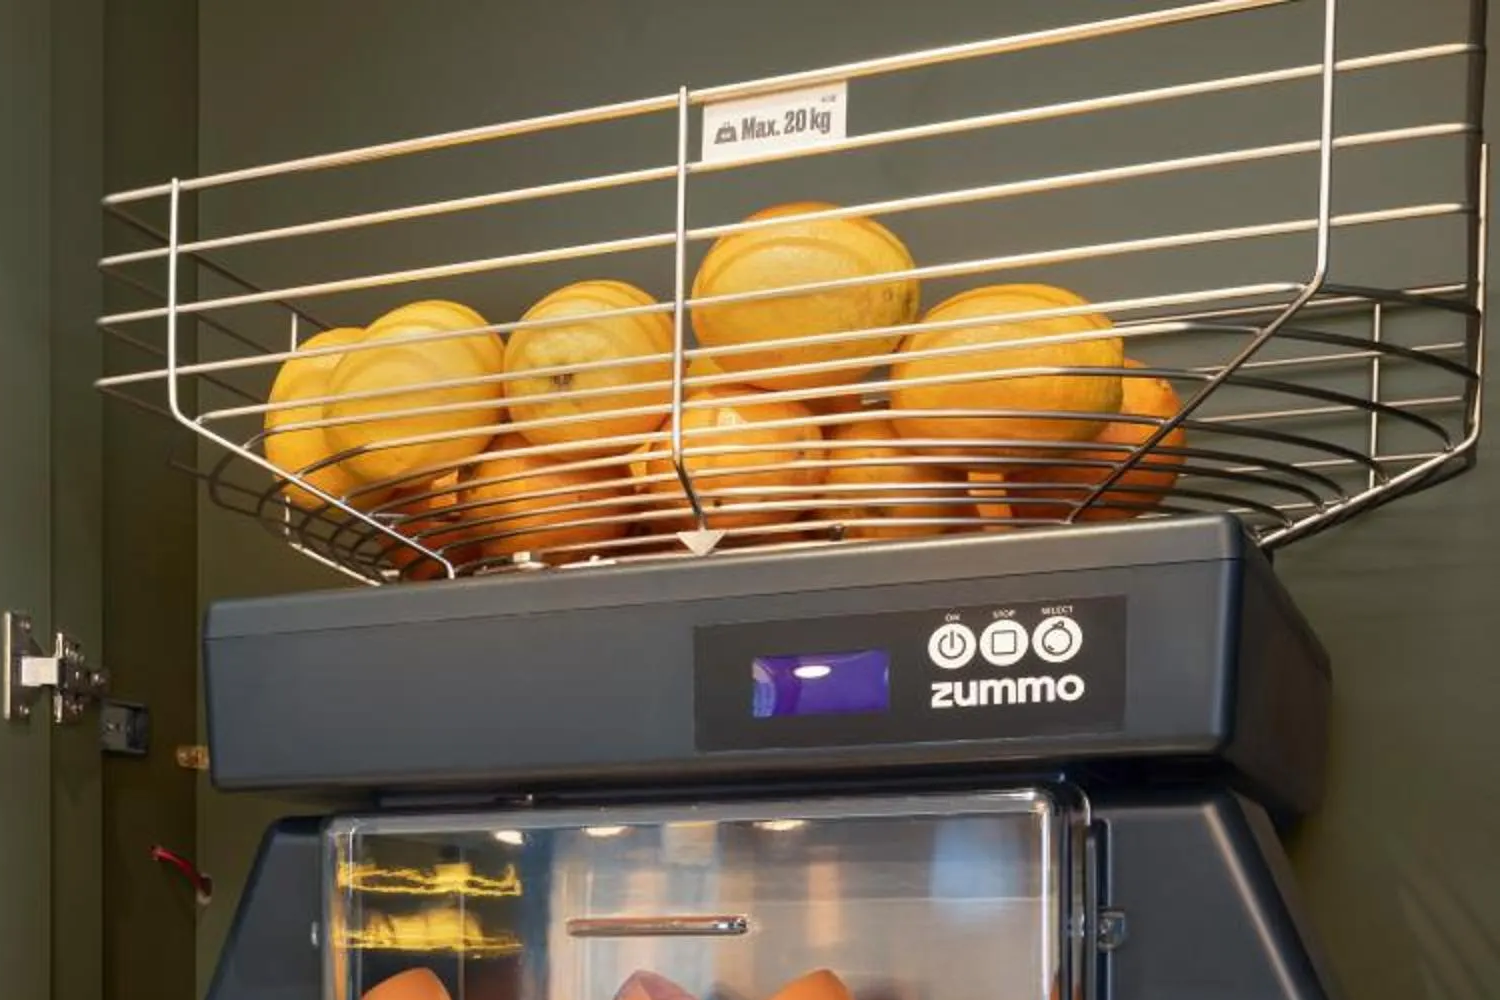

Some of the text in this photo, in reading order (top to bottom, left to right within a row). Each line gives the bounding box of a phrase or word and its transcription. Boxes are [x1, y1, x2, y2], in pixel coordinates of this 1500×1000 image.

[741, 106, 832, 141] Max. 20 kg
[930, 674, 1085, 709] zummo
